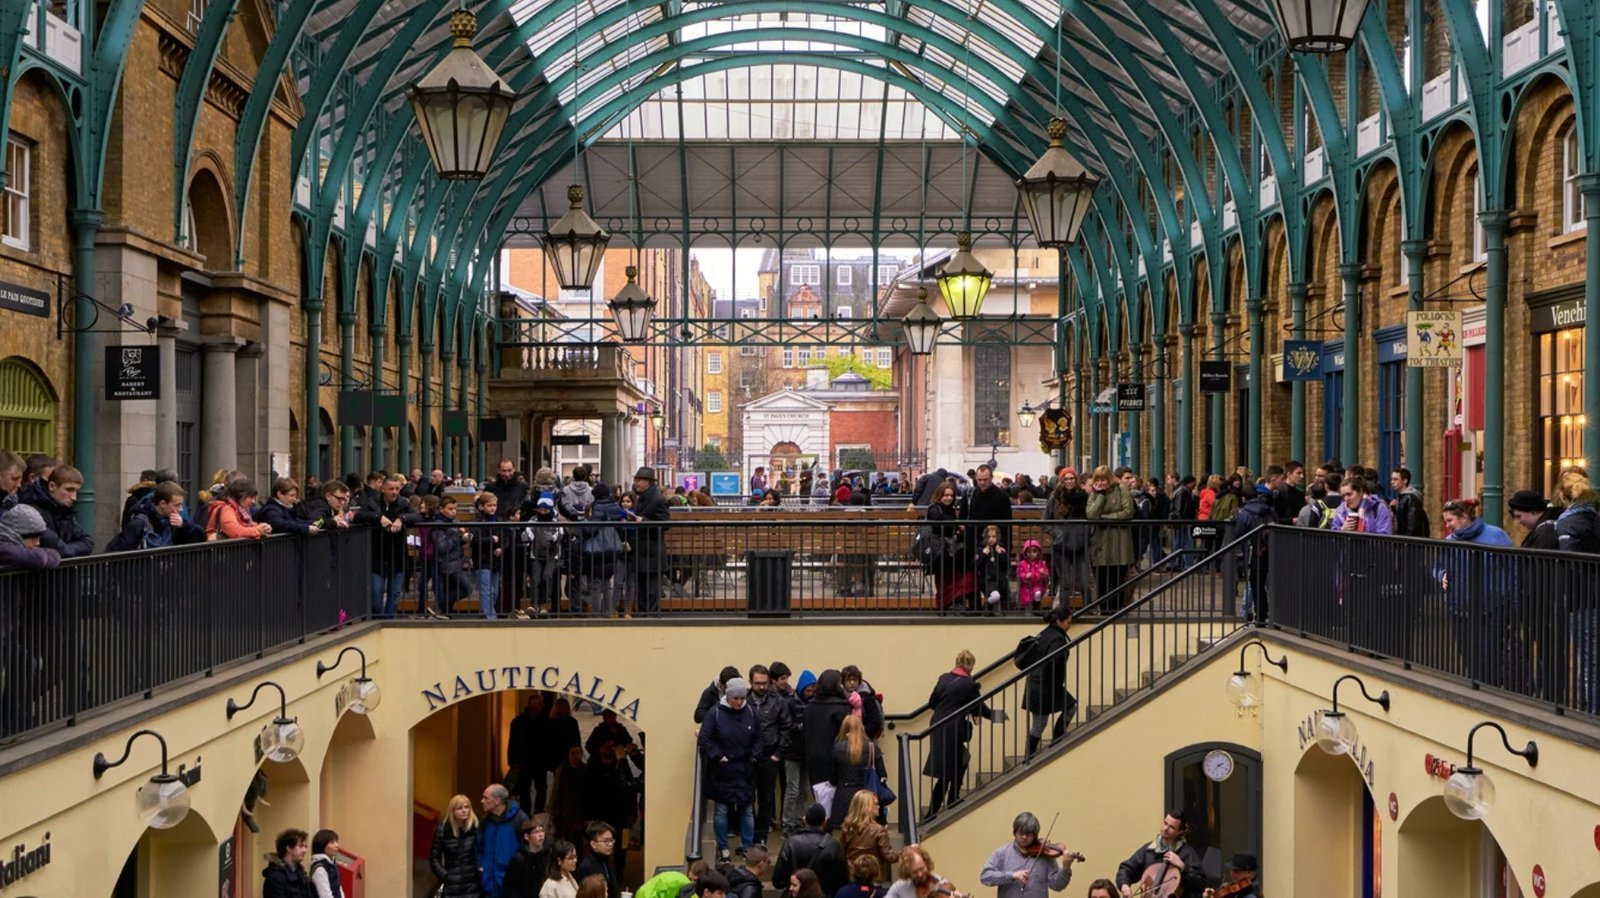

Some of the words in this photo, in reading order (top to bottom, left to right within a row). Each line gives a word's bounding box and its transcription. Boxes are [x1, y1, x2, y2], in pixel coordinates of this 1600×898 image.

[7, 291, 19, 302] PAIN
[1551, 299, 1587, 327] Venchi
[1408, 357, 1424, 366] TOY
[421, 666, 641, 722] NAUTICALIA
[1532, 873, 1545, 890] WC
